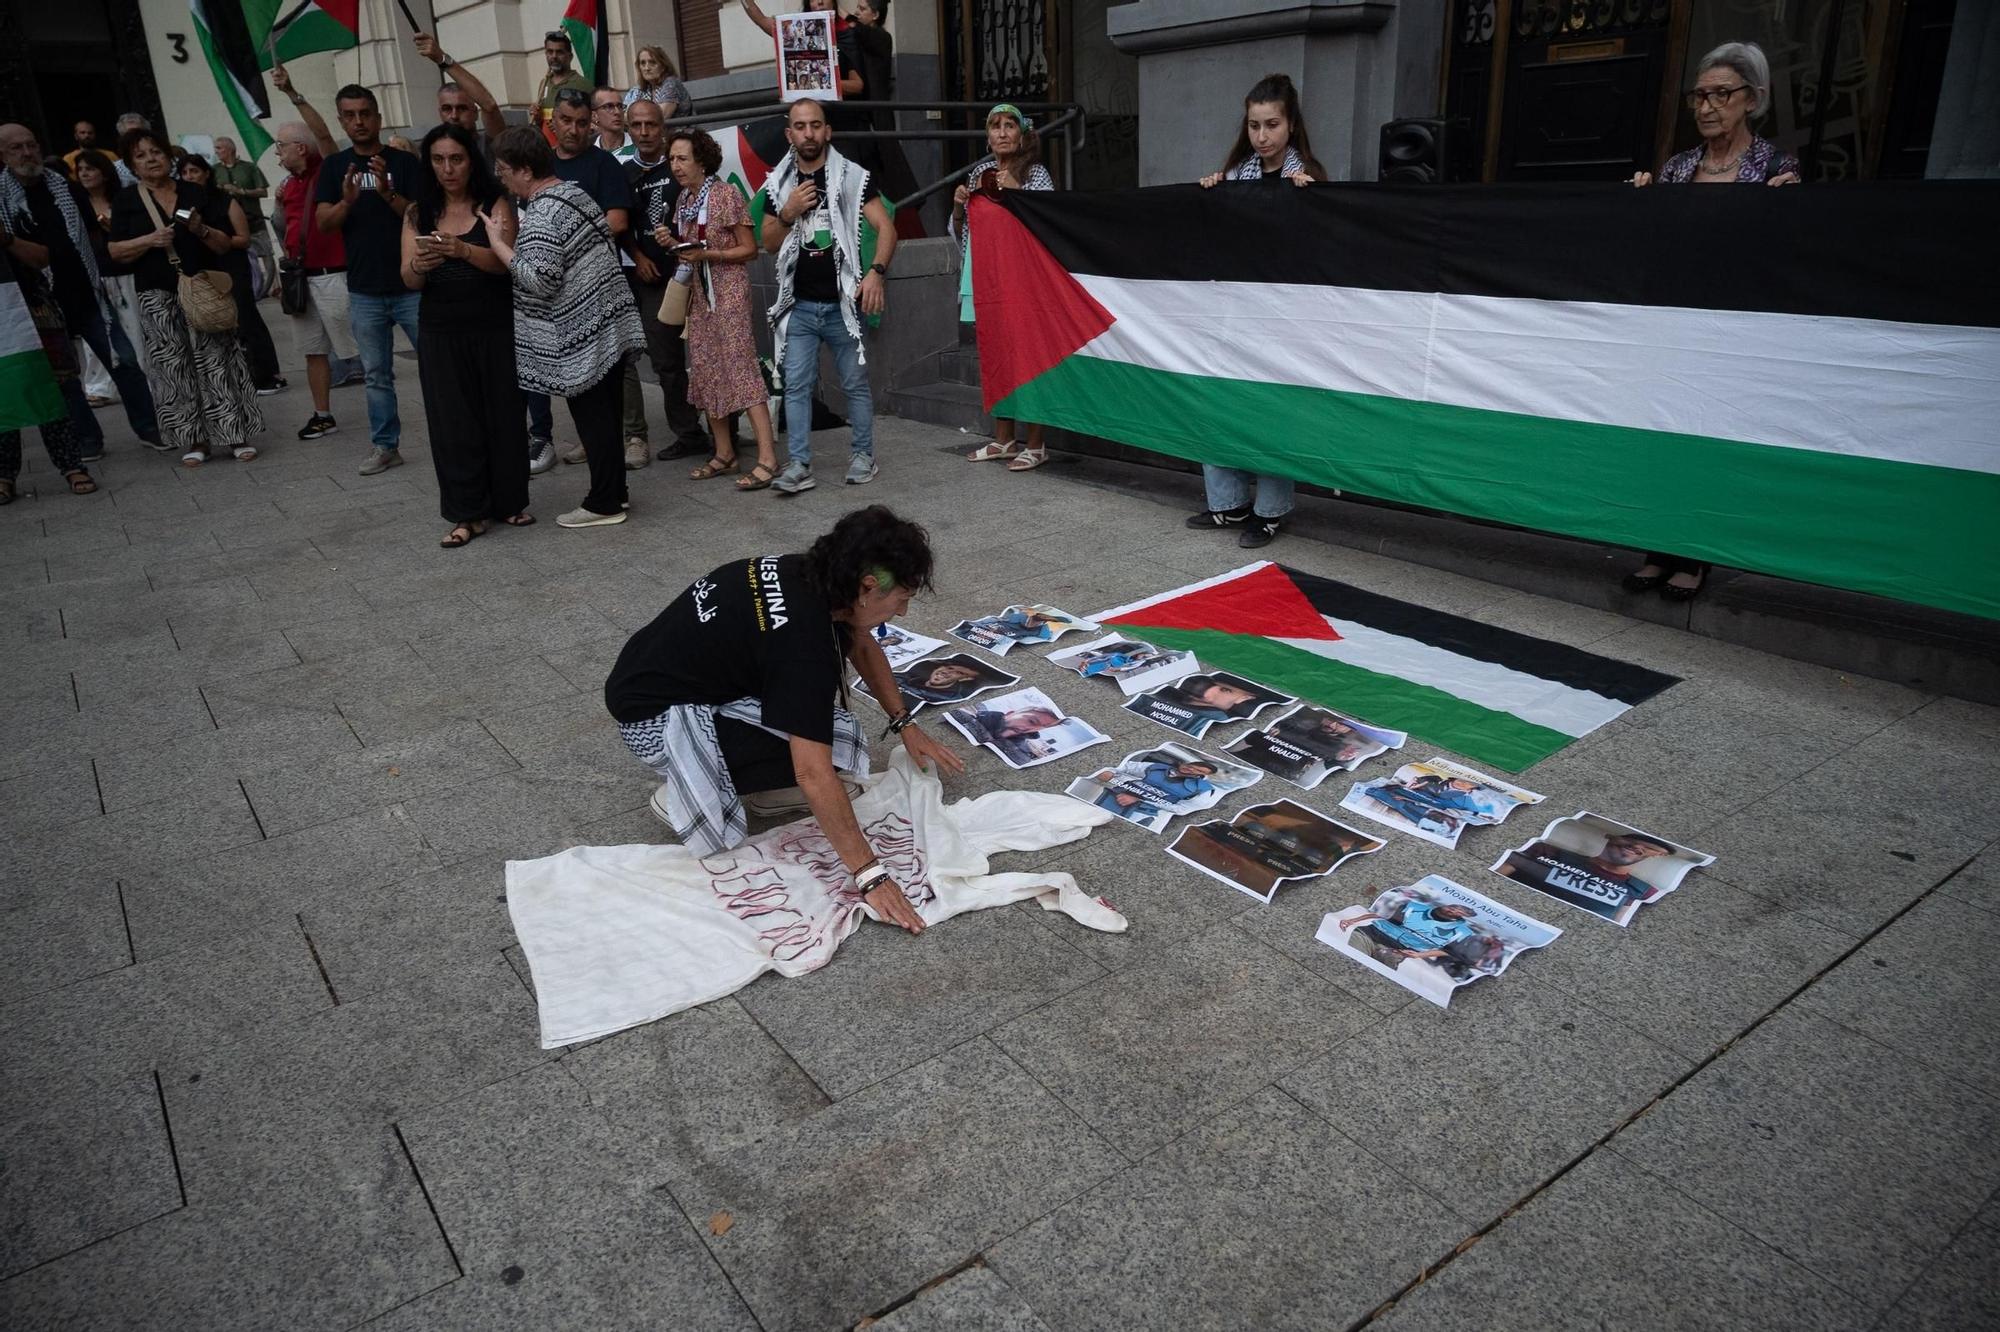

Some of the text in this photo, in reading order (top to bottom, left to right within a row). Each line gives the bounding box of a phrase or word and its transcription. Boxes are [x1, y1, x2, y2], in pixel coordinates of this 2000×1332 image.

[166, 33, 189, 64] 3
[761, 554, 789, 630] LESTINA
[754, 597, 766, 632] Palestine
[1149, 711, 1179, 726] NOUFAL
[1150, 701, 1193, 719] MOHAMMED
[1268, 744, 1303, 762] KHALIDI
[1108, 778, 1143, 796] IBRAHIM
[1227, 831, 1256, 846] PRESS
[1266, 858, 1292, 872] PRESS
[1537, 856, 1628, 894] MOAMEN ALIWA
[1552, 869, 1622, 901] PRESS
[1442, 886, 1528, 931] Moath Abu Taha
